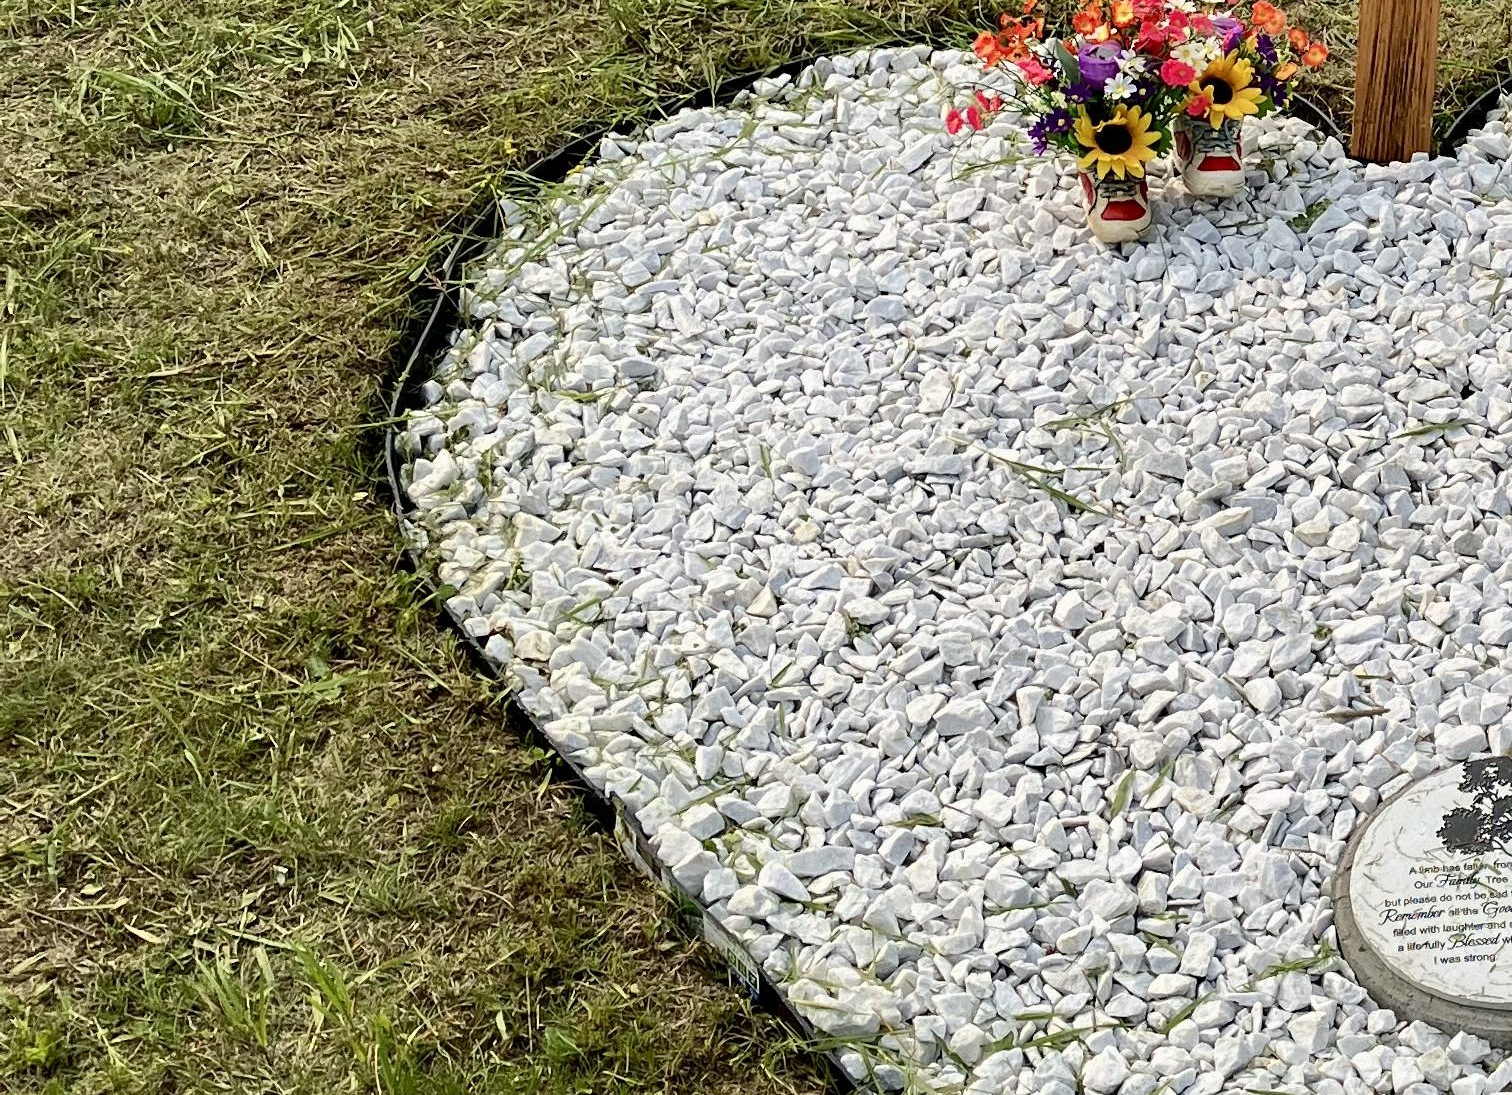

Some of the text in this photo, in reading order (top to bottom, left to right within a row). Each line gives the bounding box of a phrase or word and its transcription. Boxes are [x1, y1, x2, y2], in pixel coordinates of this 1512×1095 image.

[1408, 867, 1417, 876] A
[1442, 862, 1461, 873] has
[1414, 879, 1434, 890] Our
[1485, 874, 1509, 885] Tree
[1385, 897, 1401, 907] but
[1403, 895, 1437, 907] please
[1440, 892, 1452, 903] do
[1454, 891, 1472, 902] not
[1474, 889, 1487, 900] be
[1489, 888, 1508, 900] sad
[1378, 905, 1446, 926] Remember
[1448, 907, 1460, 917] all
[1462, 905, 1479, 916] the
[1393, 927, 1417, 938] filled
[1419, 925, 1441, 936] with
[1443, 921, 1484, 935] laughter
[1487, 920, 1507, 931] and
[1397, 944, 1405, 953] a
[1447, 932, 1503, 951] Blessed
[1434, 956, 1438, 965] I
[1439, 955, 1461, 965] was
